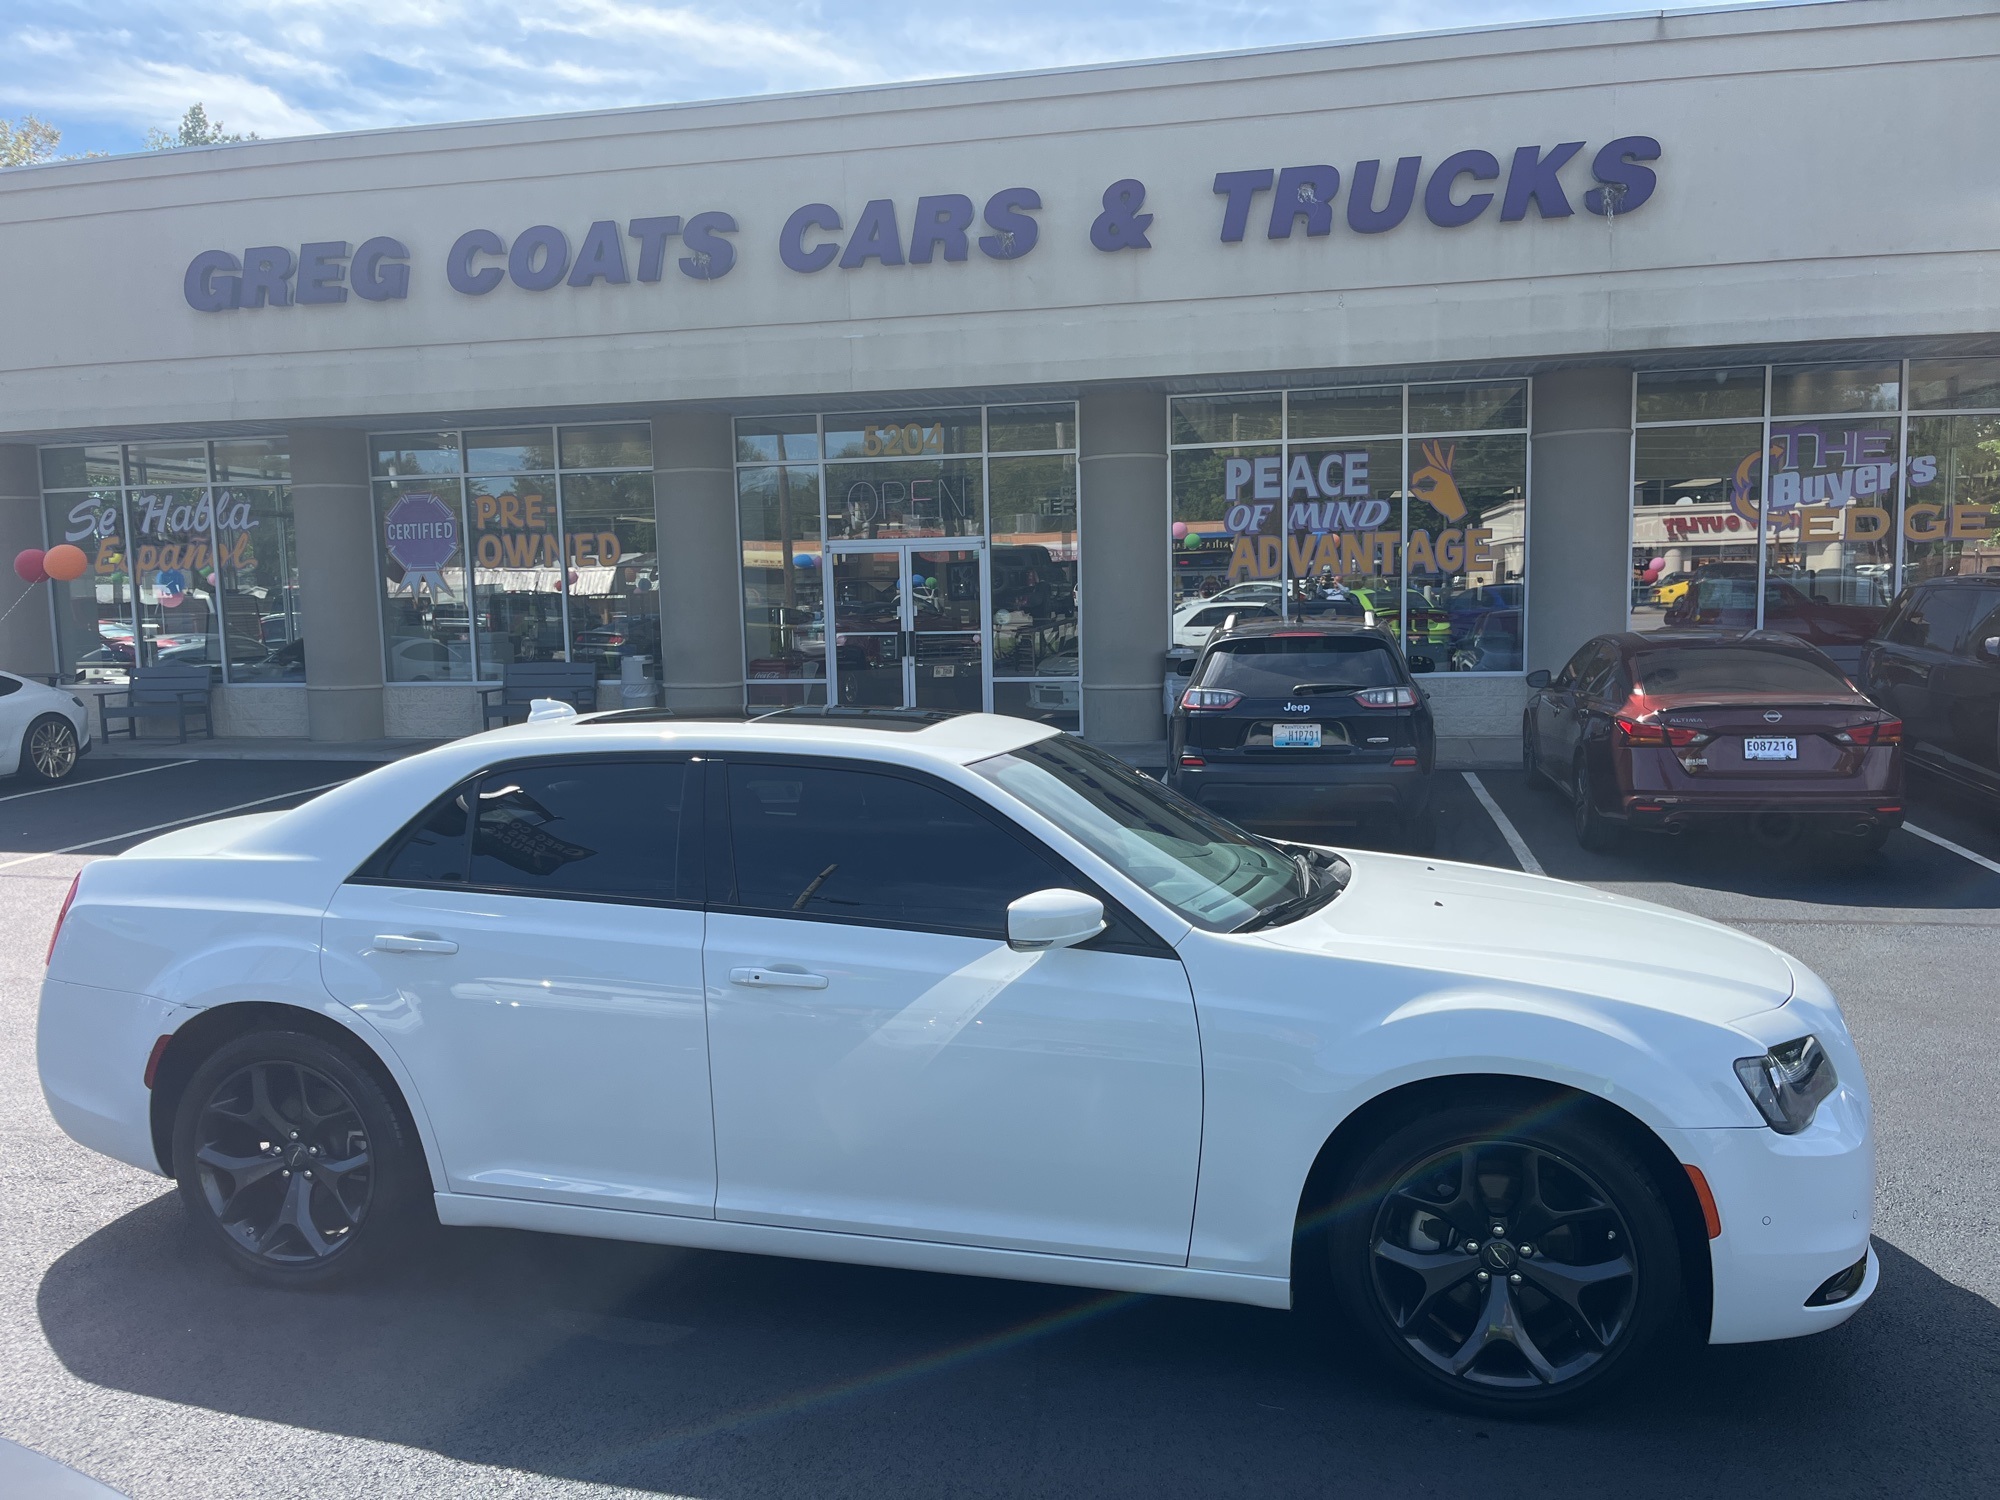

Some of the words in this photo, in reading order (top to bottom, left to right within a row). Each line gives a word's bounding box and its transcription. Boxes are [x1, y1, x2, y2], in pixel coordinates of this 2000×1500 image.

[184, 236, 410, 312] GREG
[446, 211, 739, 296] COATS
[779, 186, 1042, 272] CARS
[1090, 178, 1154, 252] &
[1211, 135, 1662, 244] TRUCKS
[864, 422, 943, 456] 5204
[1770, 428, 1892, 470] THE
[1224, 451, 1370, 500] PEACE
[1772, 455, 1938, 510] Buyer's
[66, 498, 116, 541] Se
[138, 491, 259, 533] Habla
[475, 494, 557, 530] PRE-
[847, 477, 967, 524] OPEN
[1224, 503, 1274, 534] OF
[1287, 500, 1392, 533] MIND
[387, 522, 453, 541] CERTIFIED
[1799, 503, 1992, 543] EDGE
[477, 532, 621, 568] OWNED
[1225, 527, 1494, 580] ADVANTAGE
[1283, 702, 1310, 713] Jeep
[1288, 730, 1319, 741] H1P791
[1747, 740, 1794, 751] E087216
